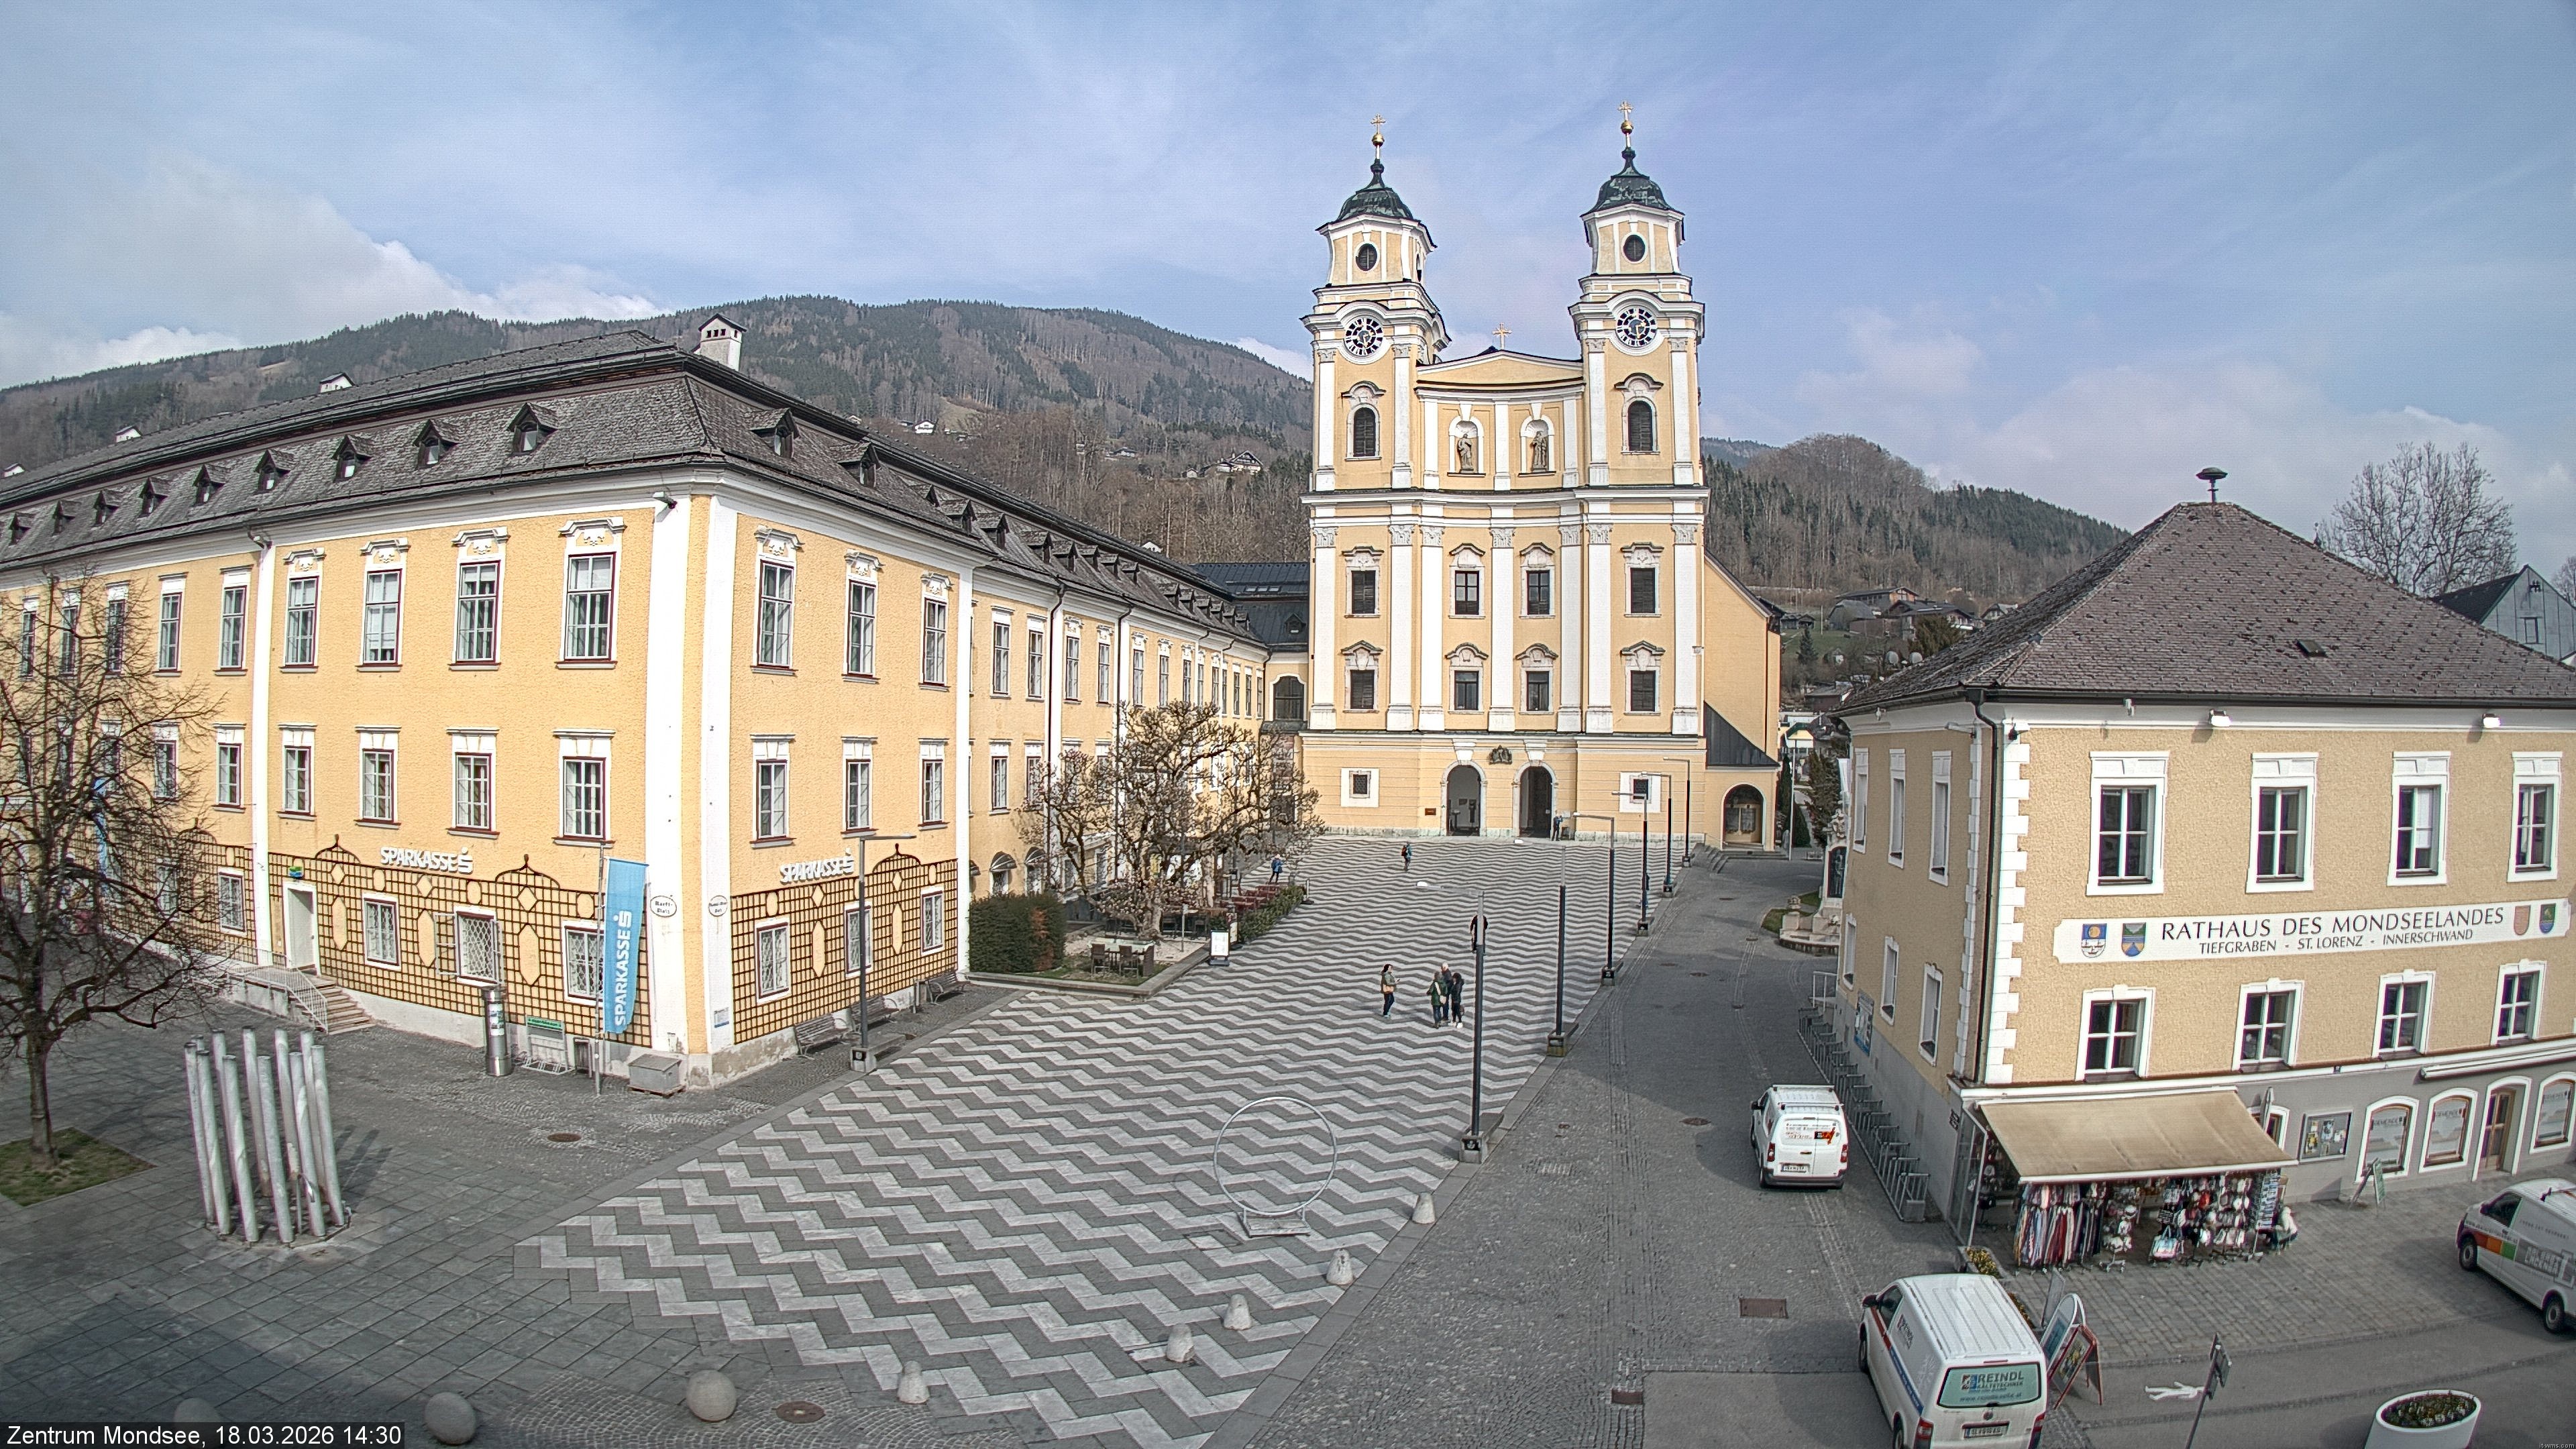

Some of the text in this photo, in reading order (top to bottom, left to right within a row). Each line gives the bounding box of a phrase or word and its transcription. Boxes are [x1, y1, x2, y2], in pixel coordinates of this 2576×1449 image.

[380, 847, 458, 872] SPARKASSE
[780, 856, 844, 883] SPARKASSE
[2161, 907, 2504, 940] RATHAUS DES MONDSEELANDES
[2199, 939, 2277, 955] TIEFGRABEN
[2297, 937, 2313, 951] ST.
[2317, 934, 2363, 949] LORENZ
[2383, 928, 2473, 946] INNERSCHWAND
[614, 928, 631, 1026] SPARKASSE
[1978, 1371, 2025, 1383] REINDL
